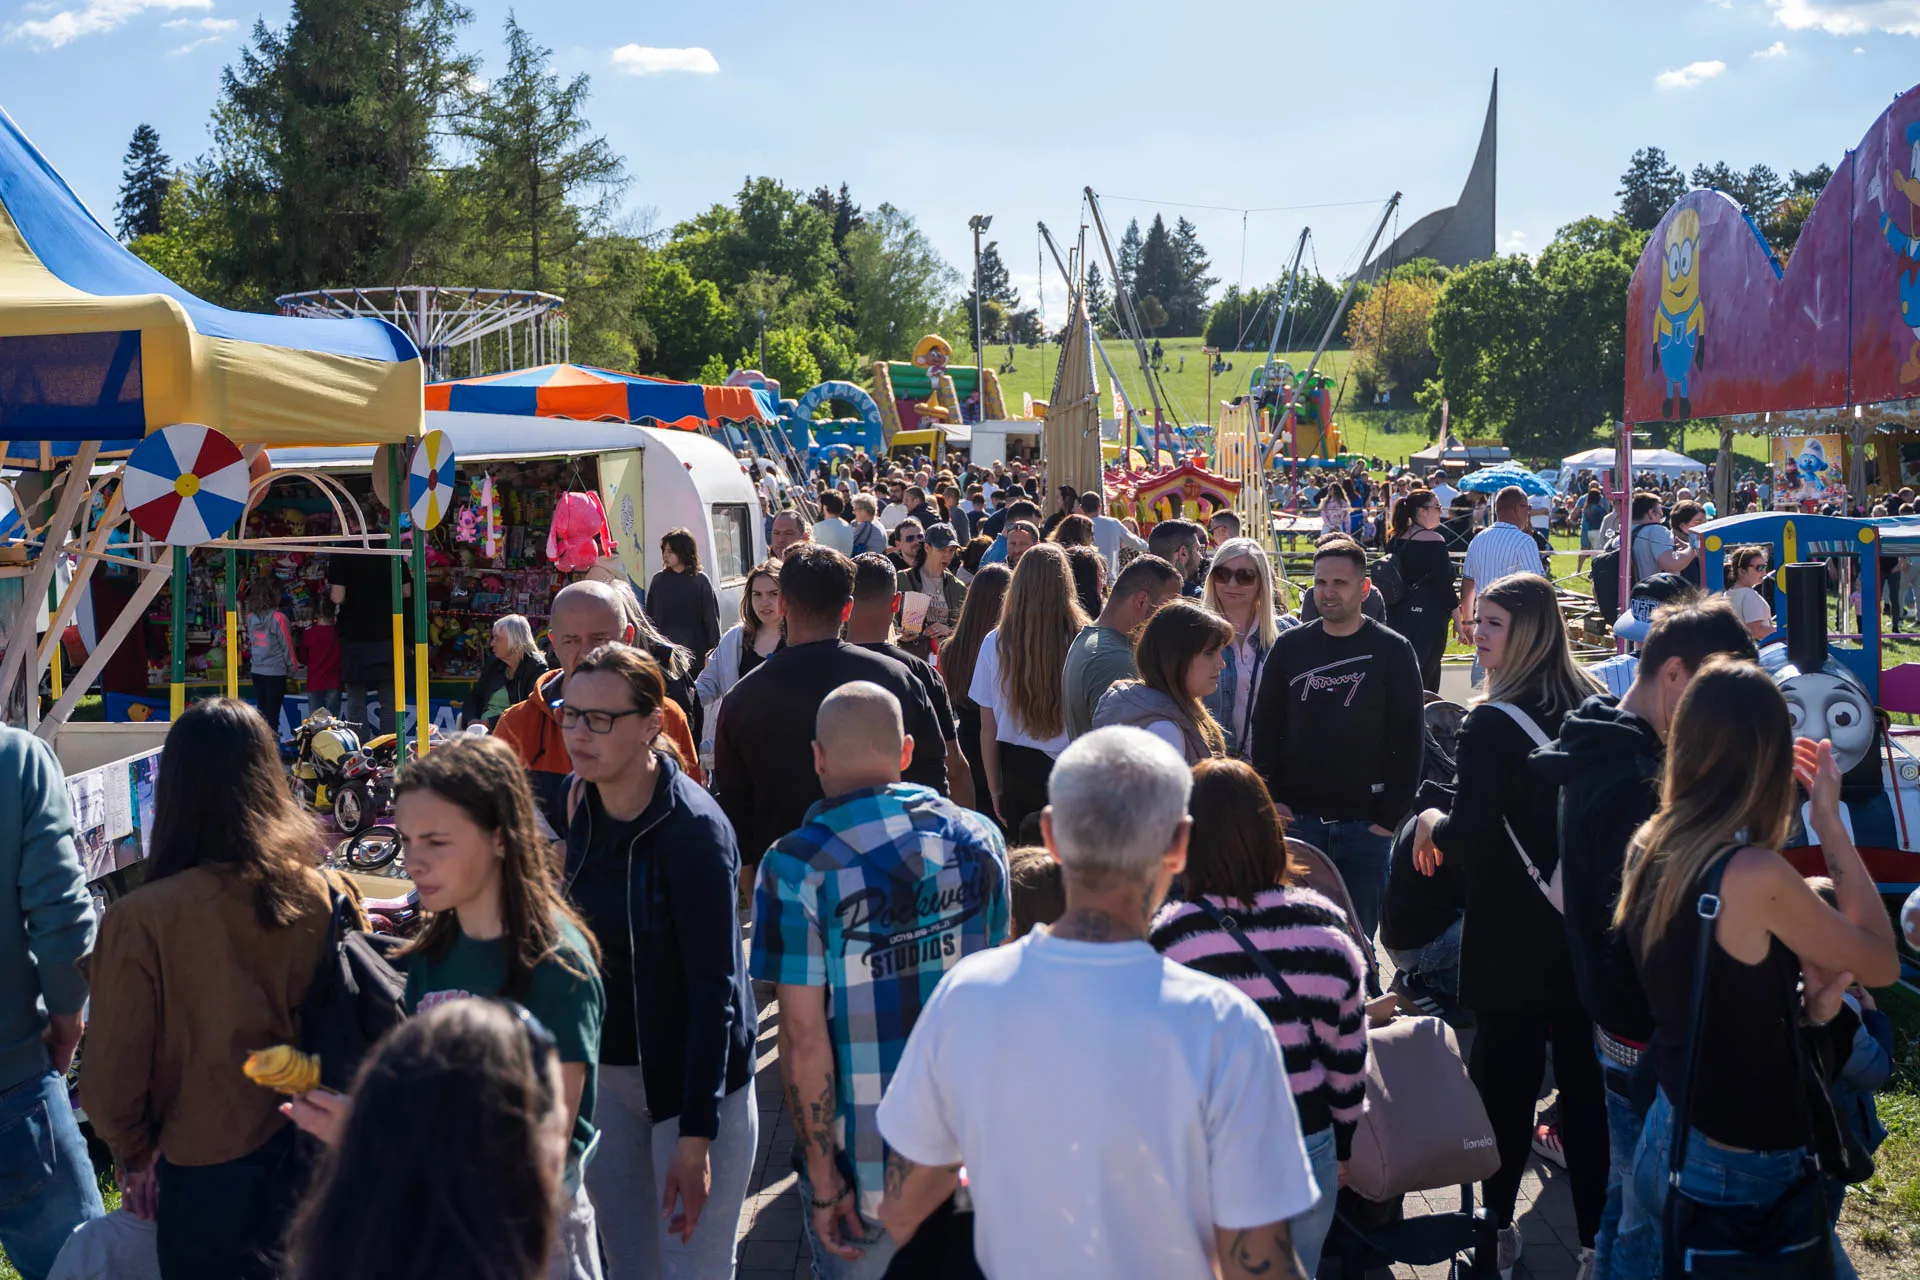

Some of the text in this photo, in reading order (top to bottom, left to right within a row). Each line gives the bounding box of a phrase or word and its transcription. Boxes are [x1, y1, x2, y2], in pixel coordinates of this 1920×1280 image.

[1289, 654, 1373, 706] Tommy
[870, 932, 956, 979] STUDIOS
[1463, 1135, 1493, 1150] lionelo
